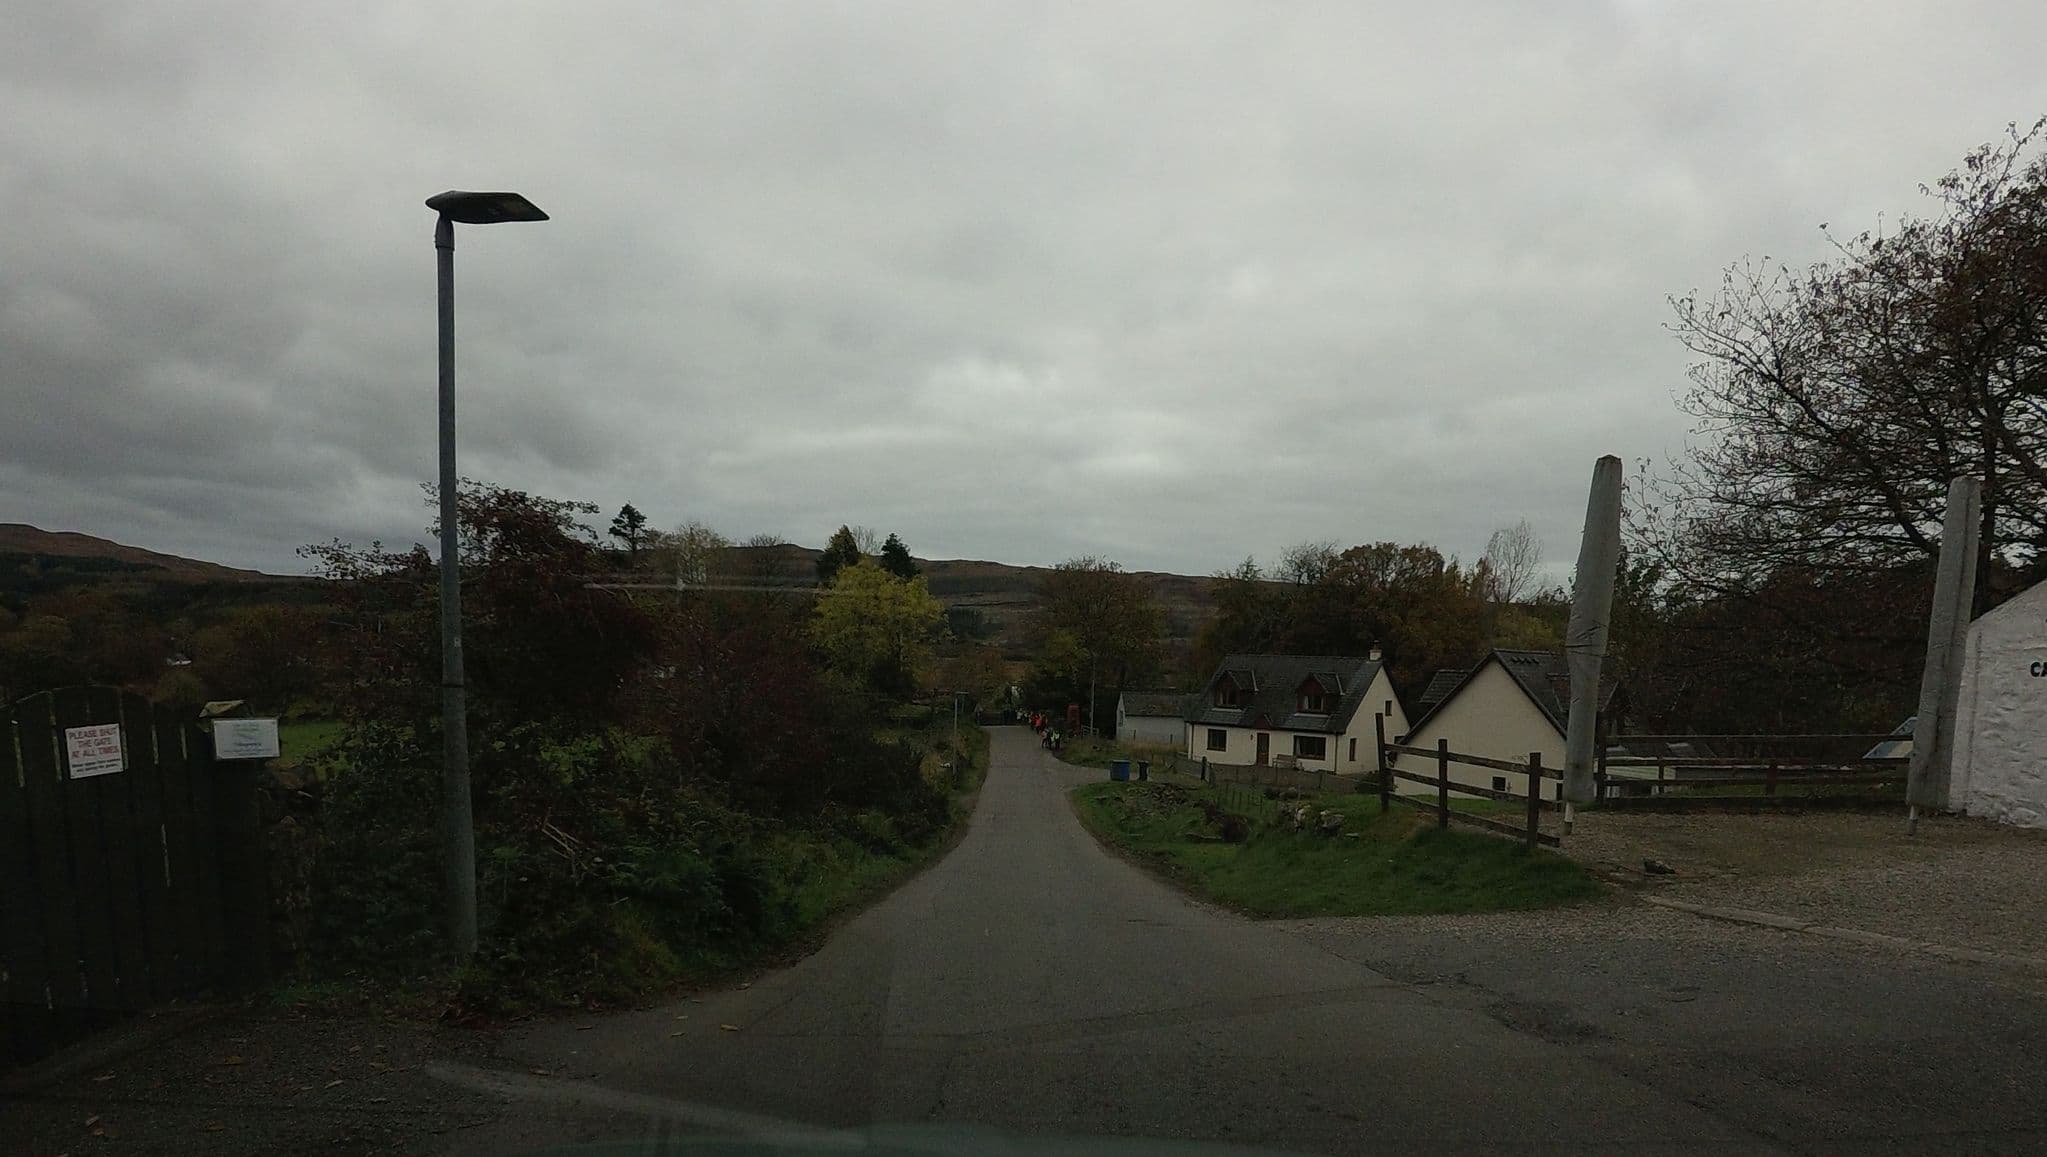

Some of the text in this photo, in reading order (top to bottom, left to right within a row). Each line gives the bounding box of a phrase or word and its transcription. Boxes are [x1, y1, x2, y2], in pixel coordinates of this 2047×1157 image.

[68, 730, 97, 740] PLEASE
[78, 737, 112, 748] THE GATE
[72, 745, 119, 758] AT ALL TIMES
